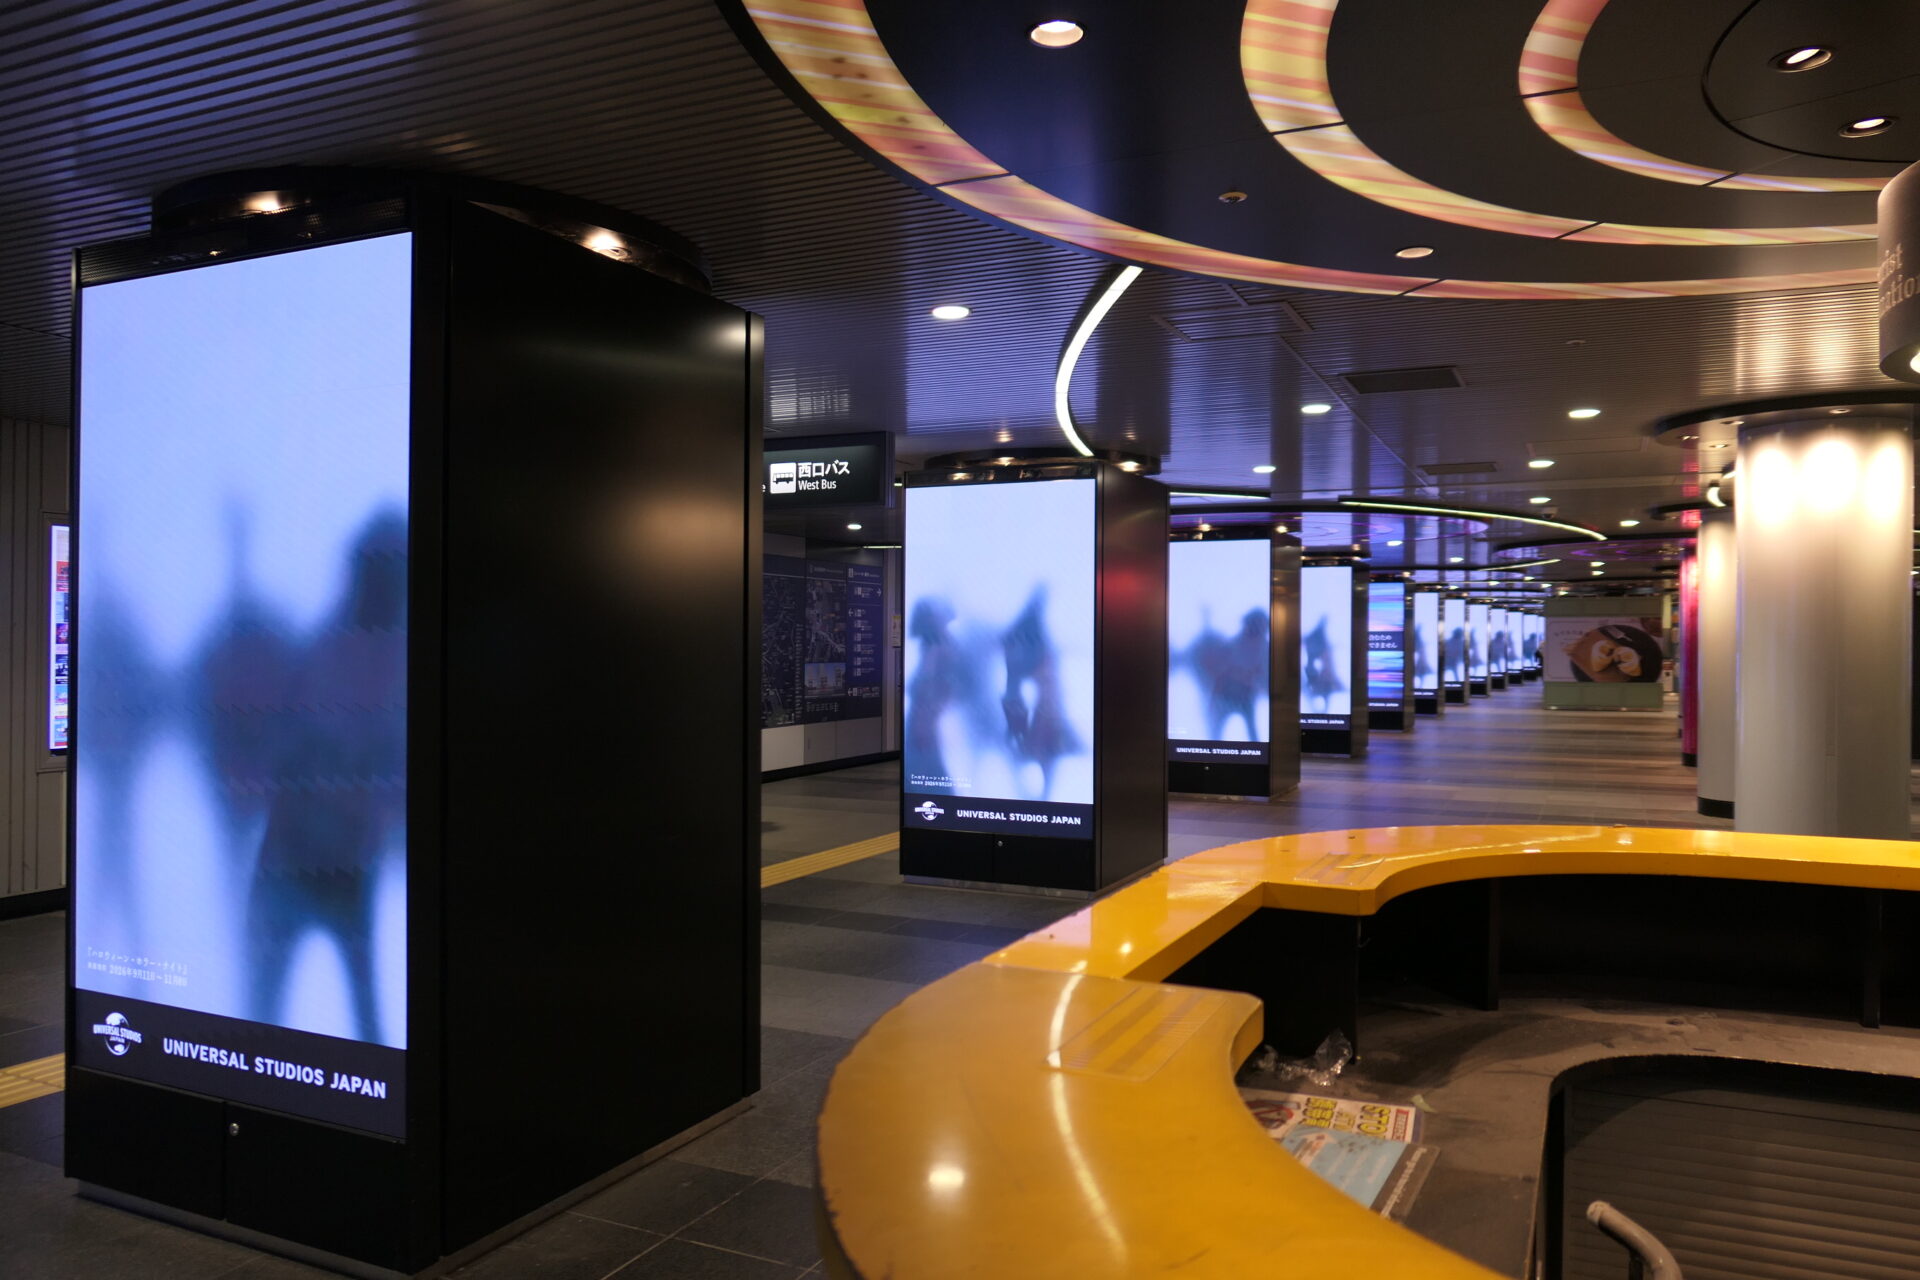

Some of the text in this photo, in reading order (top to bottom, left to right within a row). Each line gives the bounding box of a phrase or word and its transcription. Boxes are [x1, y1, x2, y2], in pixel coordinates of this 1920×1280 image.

[798, 460, 850, 478] 西口バス
[799, 479, 837, 490] West Bus
[1176, 747, 1262, 757] UNIVERSAL STUDIOS JAPAN
[957, 809, 1007, 821] UNIVERSAL
[1009, 813, 1049, 824] STUDIOS
[1050, 815, 1081, 826] JAPAN
[163, 1037, 386, 1099] UNIVERSAL STUDIOS JAPAN
